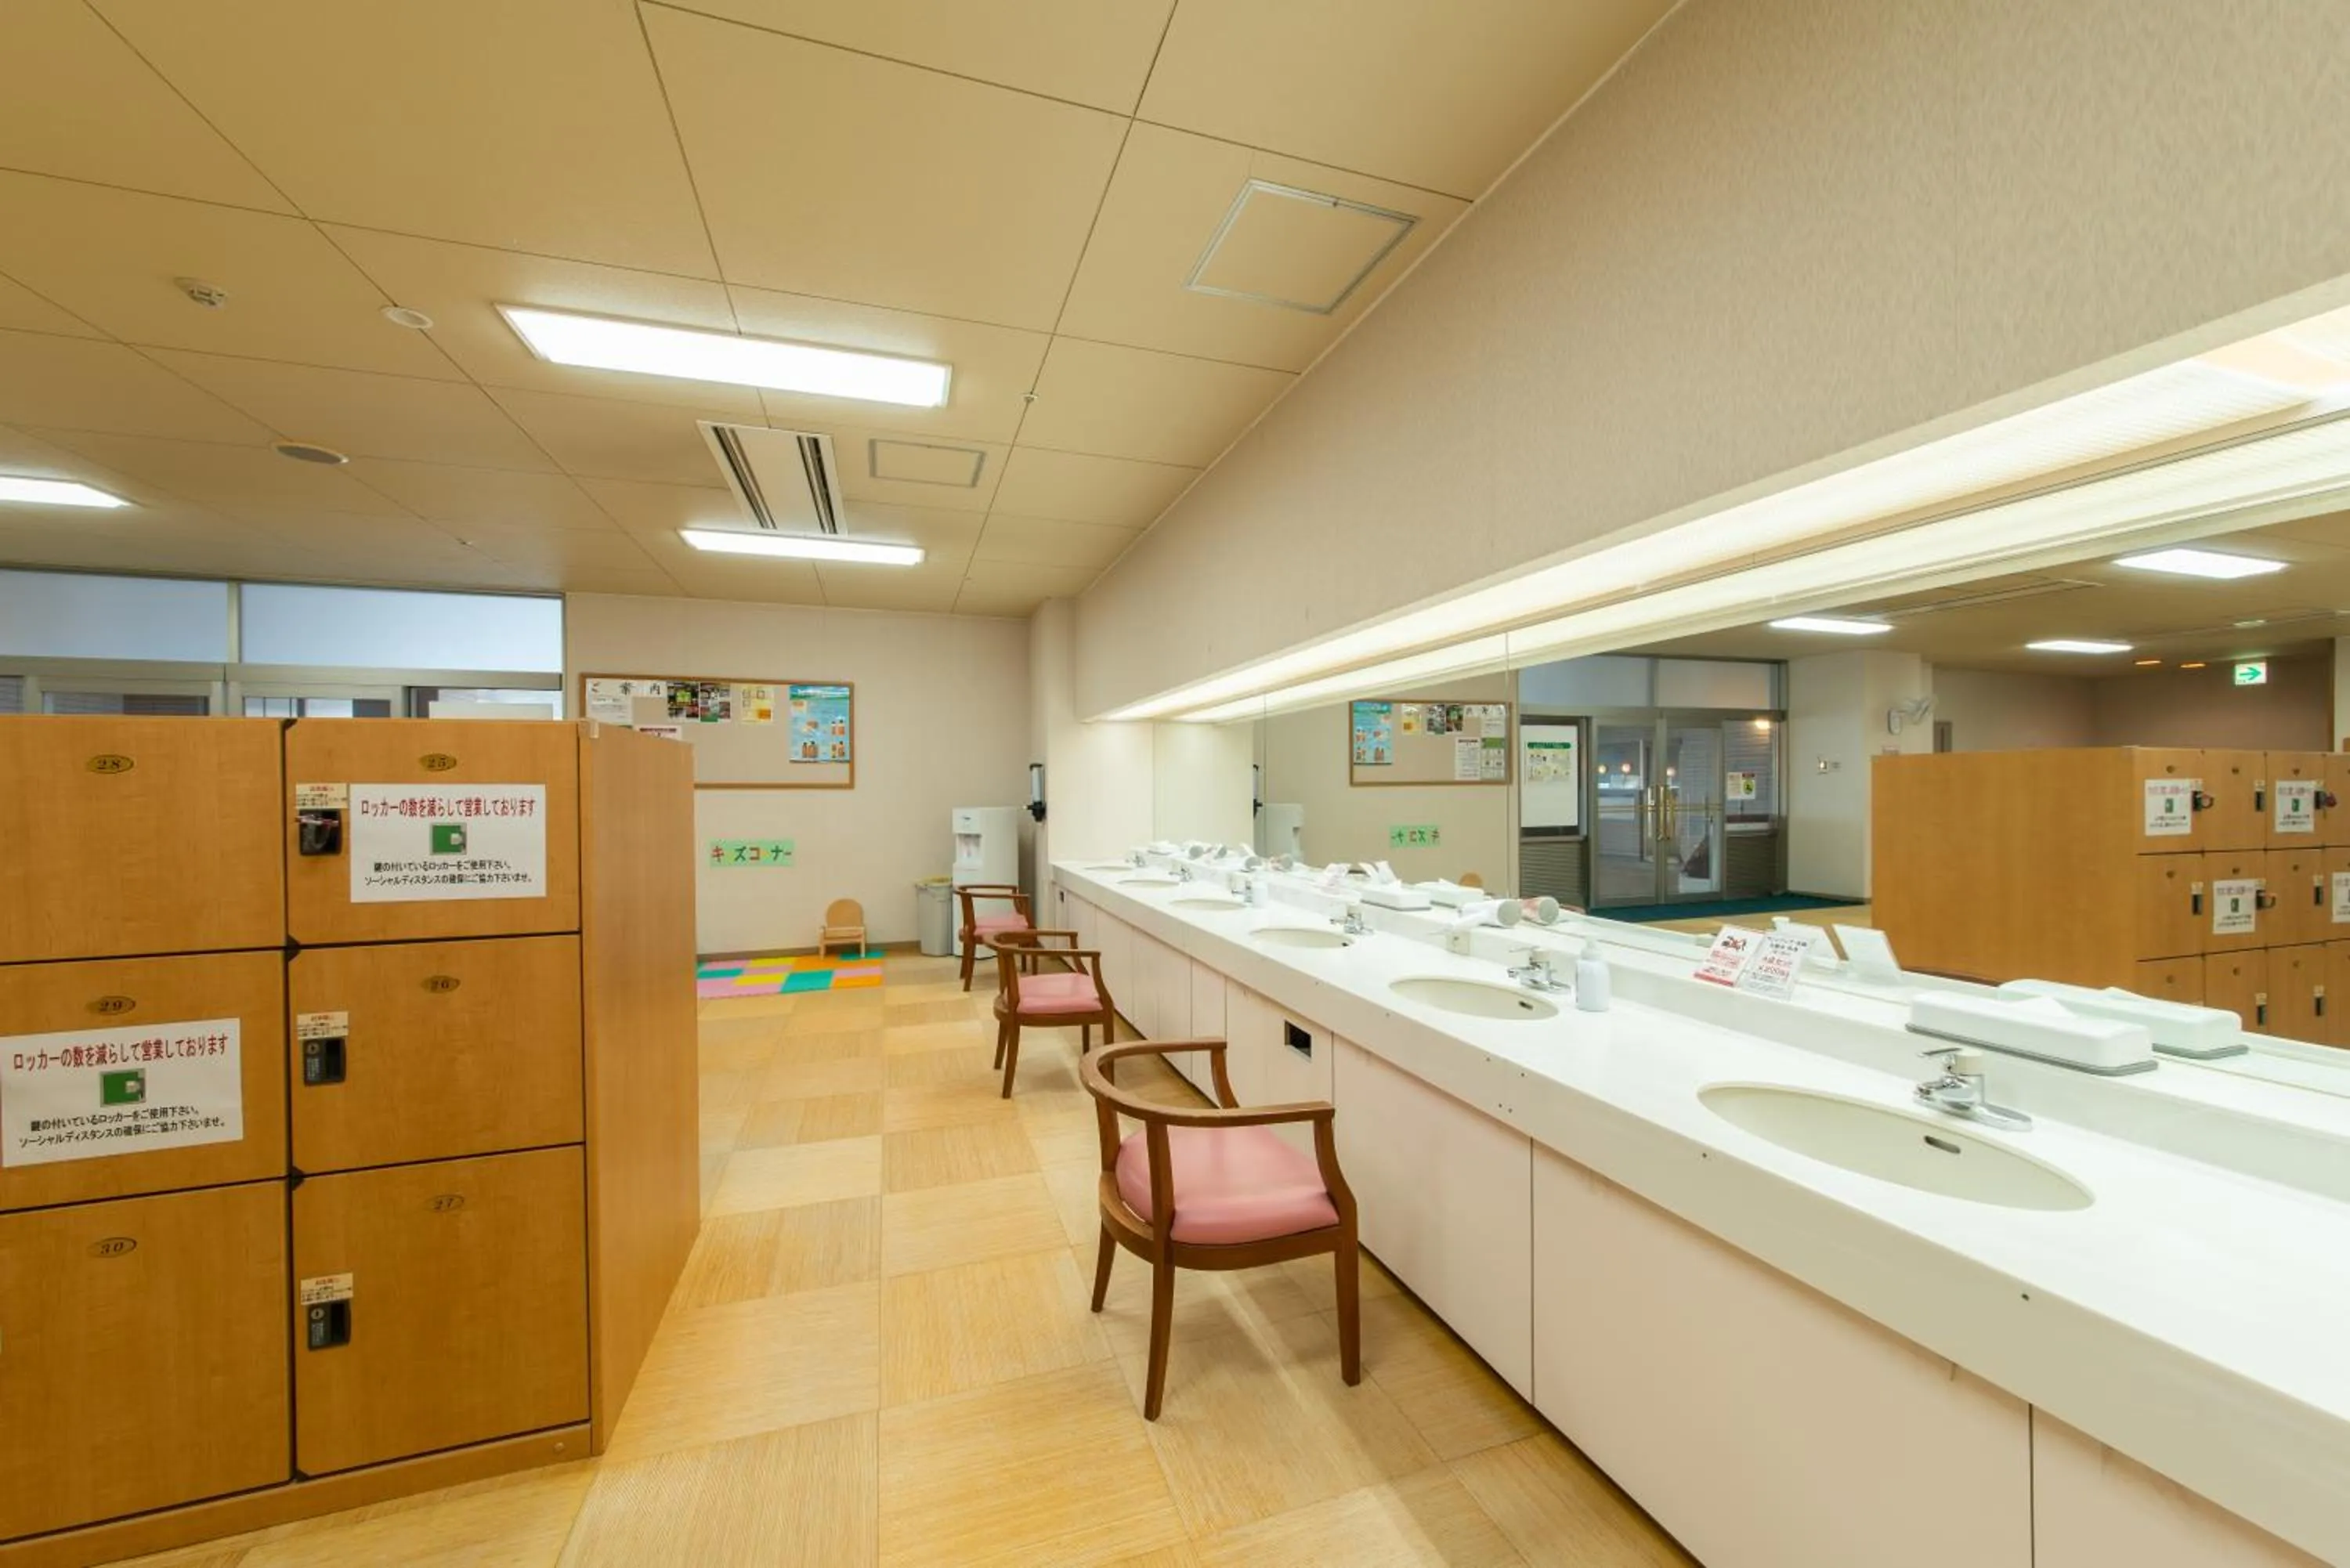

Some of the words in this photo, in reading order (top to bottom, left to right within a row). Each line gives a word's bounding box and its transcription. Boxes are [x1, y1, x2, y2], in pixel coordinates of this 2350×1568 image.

[97, 758, 121, 770] 28
[428, 757, 446, 768] 25
[361, 797, 536, 817] ロッカーの数を減らして営業しております
[13, 1033, 228, 1071] ロッカーの数を減らして営業しております
[31, 1105, 199, 1132] 鍵の付いているロッカーをご使用下さい。
[20, 1117, 225, 1148] ソーシャルディスタンスの確保にご協力下さいませ。
[100, 1242, 123, 1254] 30
